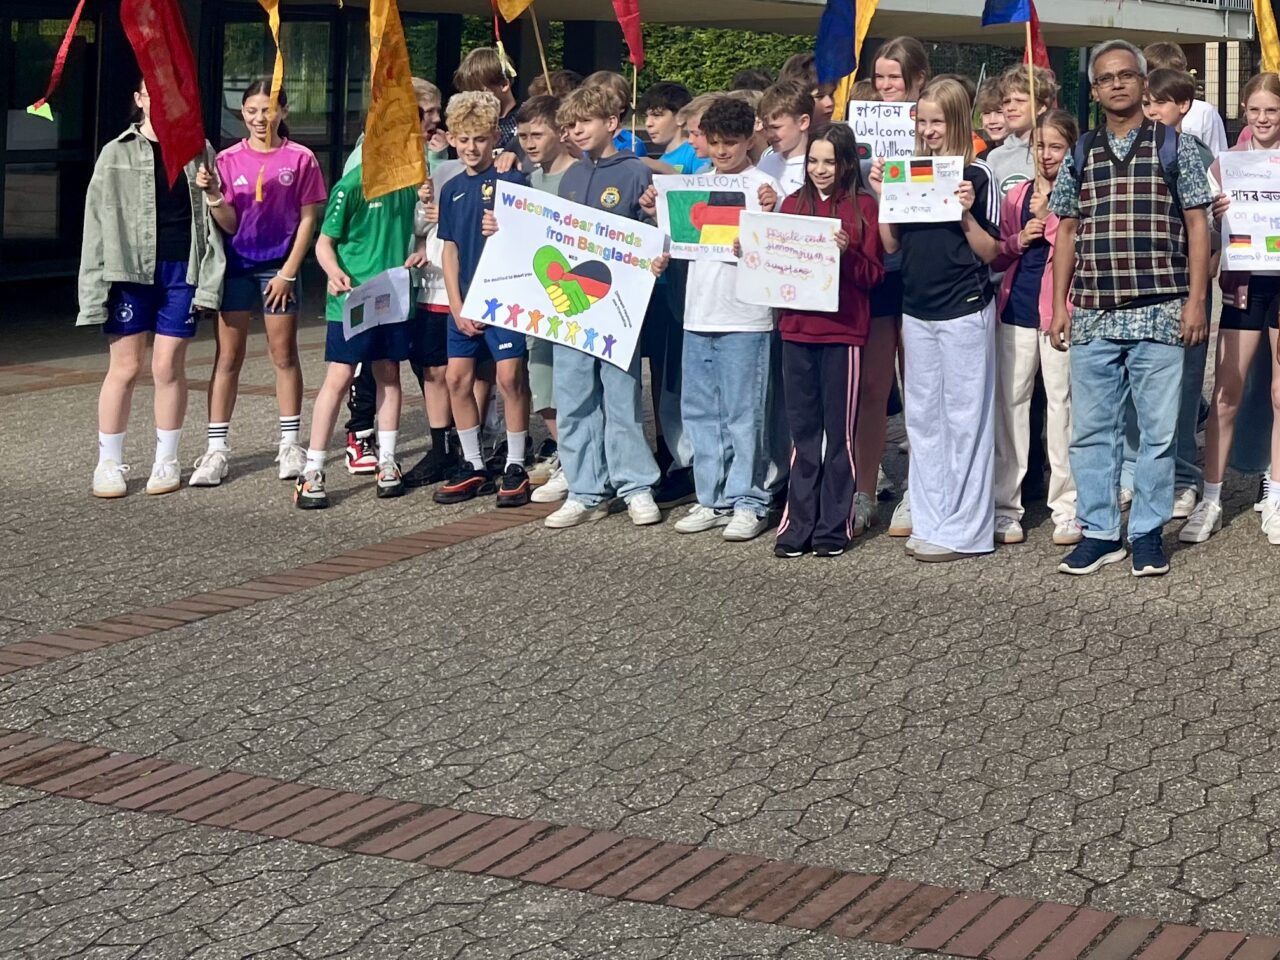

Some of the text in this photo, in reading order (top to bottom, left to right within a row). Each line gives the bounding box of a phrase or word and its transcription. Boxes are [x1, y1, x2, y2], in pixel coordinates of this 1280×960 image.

[855, 120, 915, 137] Welcome
[875, 140, 916, 158] Willkom
[683, 176, 752, 189] WELCOME
[502, 192, 642, 247] Welcome, dear friends
[546, 226, 575, 247] from
